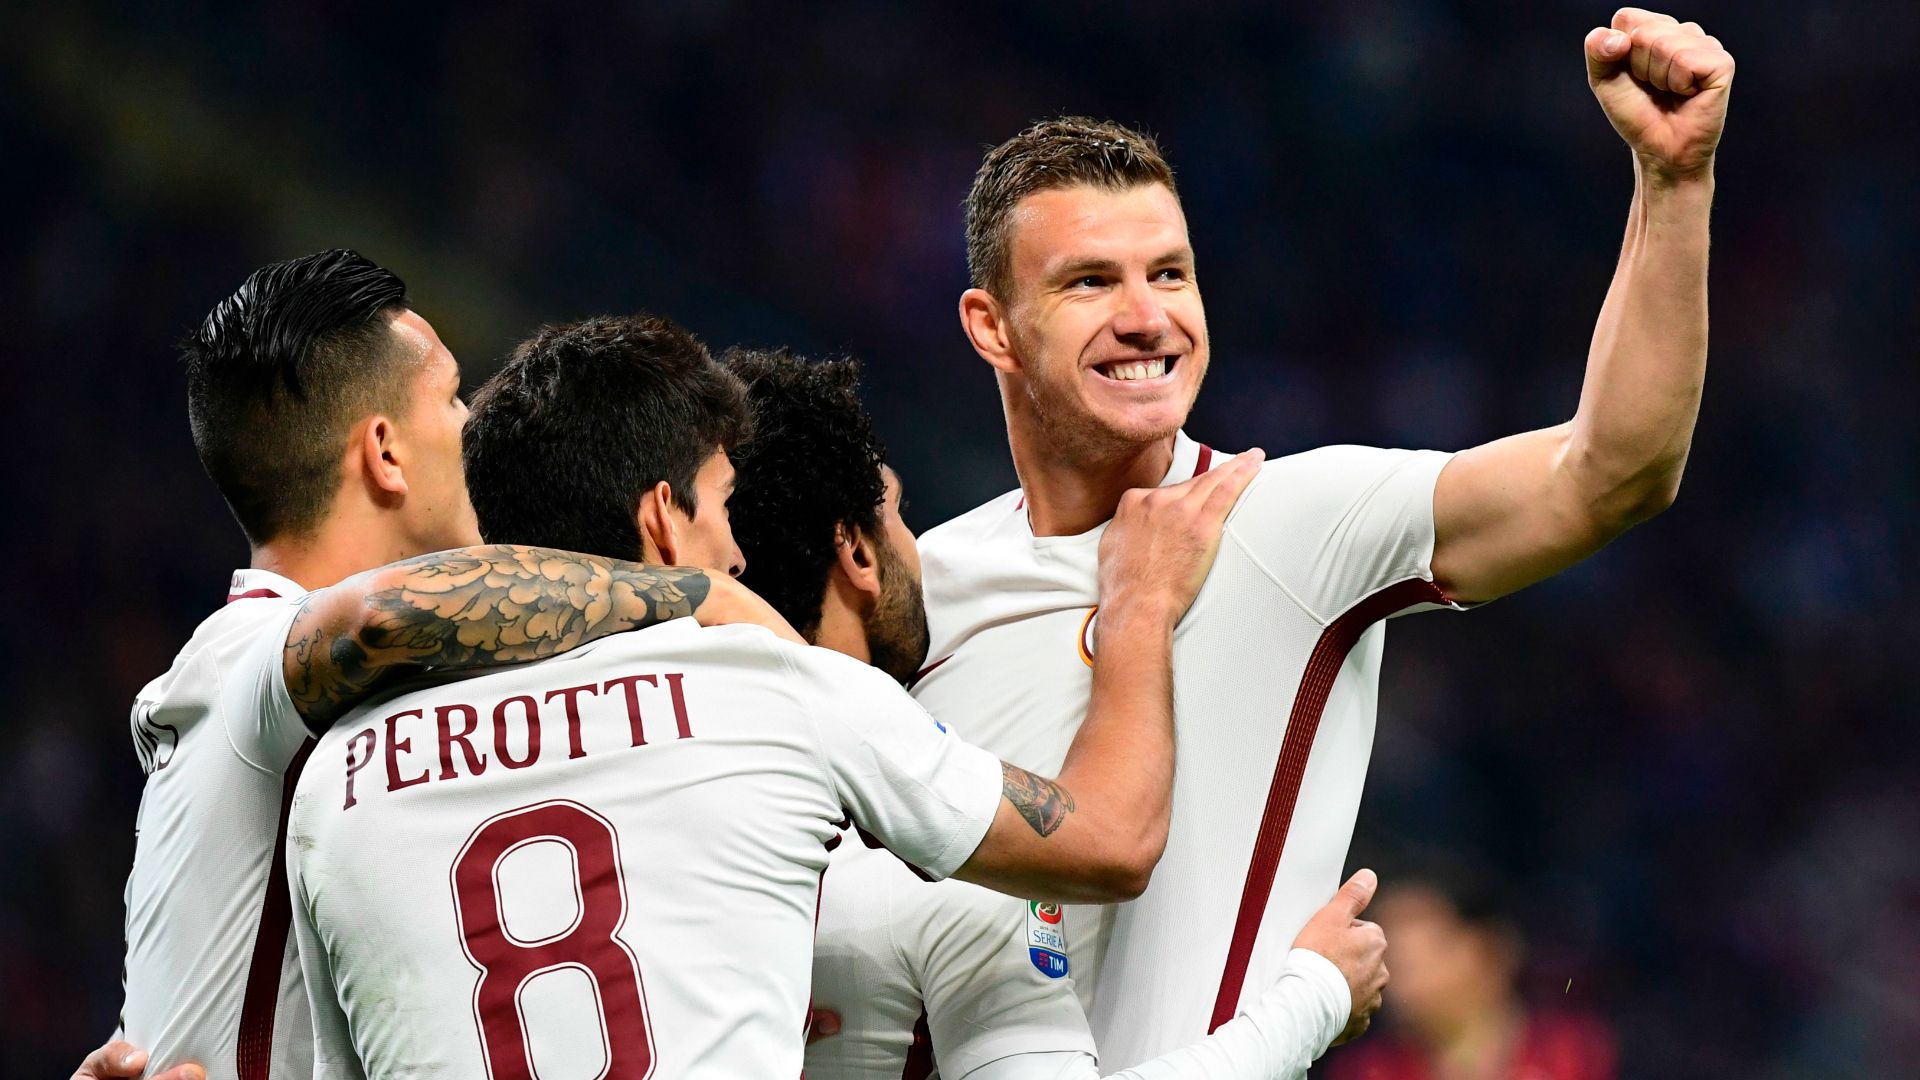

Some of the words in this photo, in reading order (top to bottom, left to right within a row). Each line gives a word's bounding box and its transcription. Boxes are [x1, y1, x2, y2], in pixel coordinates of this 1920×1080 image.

[343, 673, 695, 811] PEROTTI
[449, 799, 657, 1080] 8
[1033, 930, 1058, 947] SERIE
[1058, 937, 1063, 950] A
[1049, 955, 1064, 973] TIM
